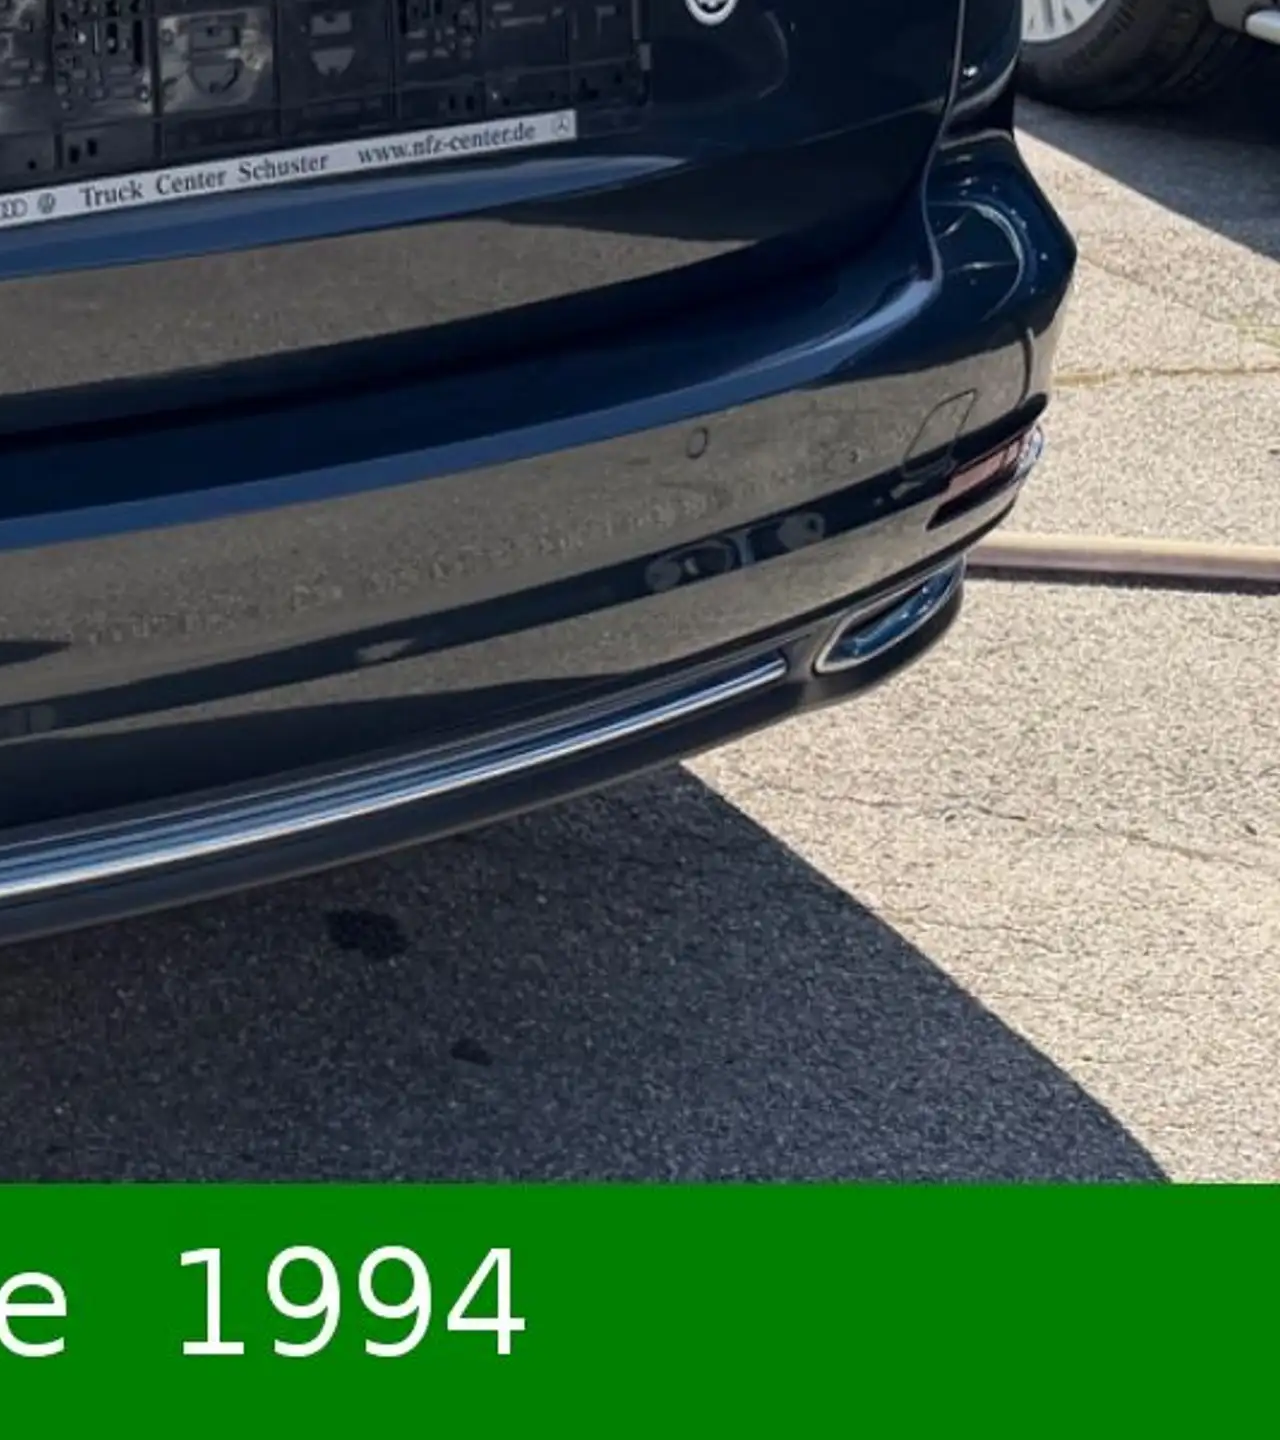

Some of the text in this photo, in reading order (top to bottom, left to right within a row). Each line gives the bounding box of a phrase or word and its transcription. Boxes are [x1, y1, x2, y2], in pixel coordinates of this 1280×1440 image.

[79, 121, 536, 208] Truck Center Schuster www.nfz-center.de
